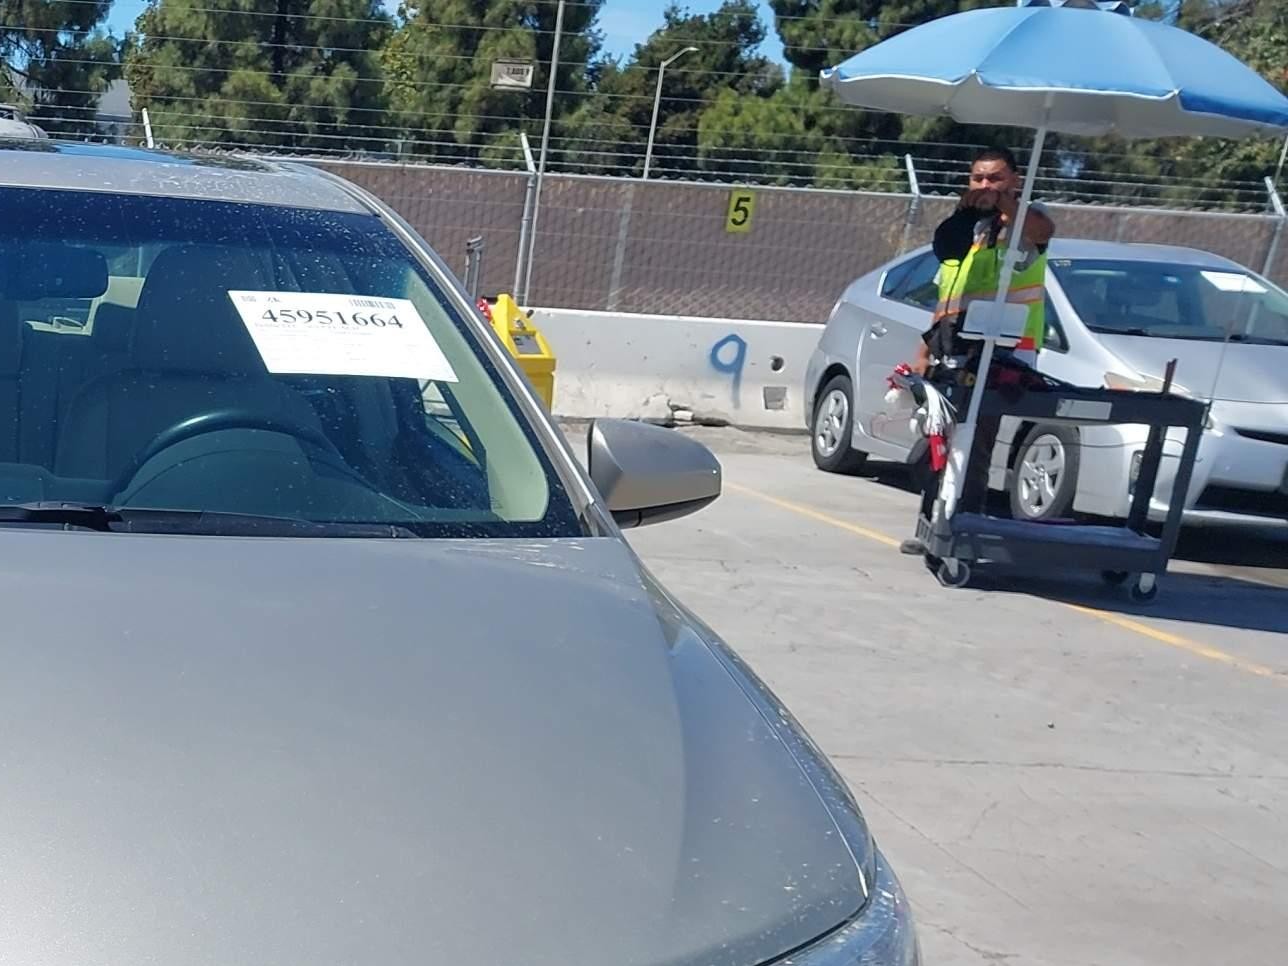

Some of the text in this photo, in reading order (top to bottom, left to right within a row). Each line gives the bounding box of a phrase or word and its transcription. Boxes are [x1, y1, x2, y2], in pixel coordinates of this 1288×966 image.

[730, 196, 752, 226] 5
[261, 309, 404, 329] 45951664
[709, 333, 748, 409] 9
